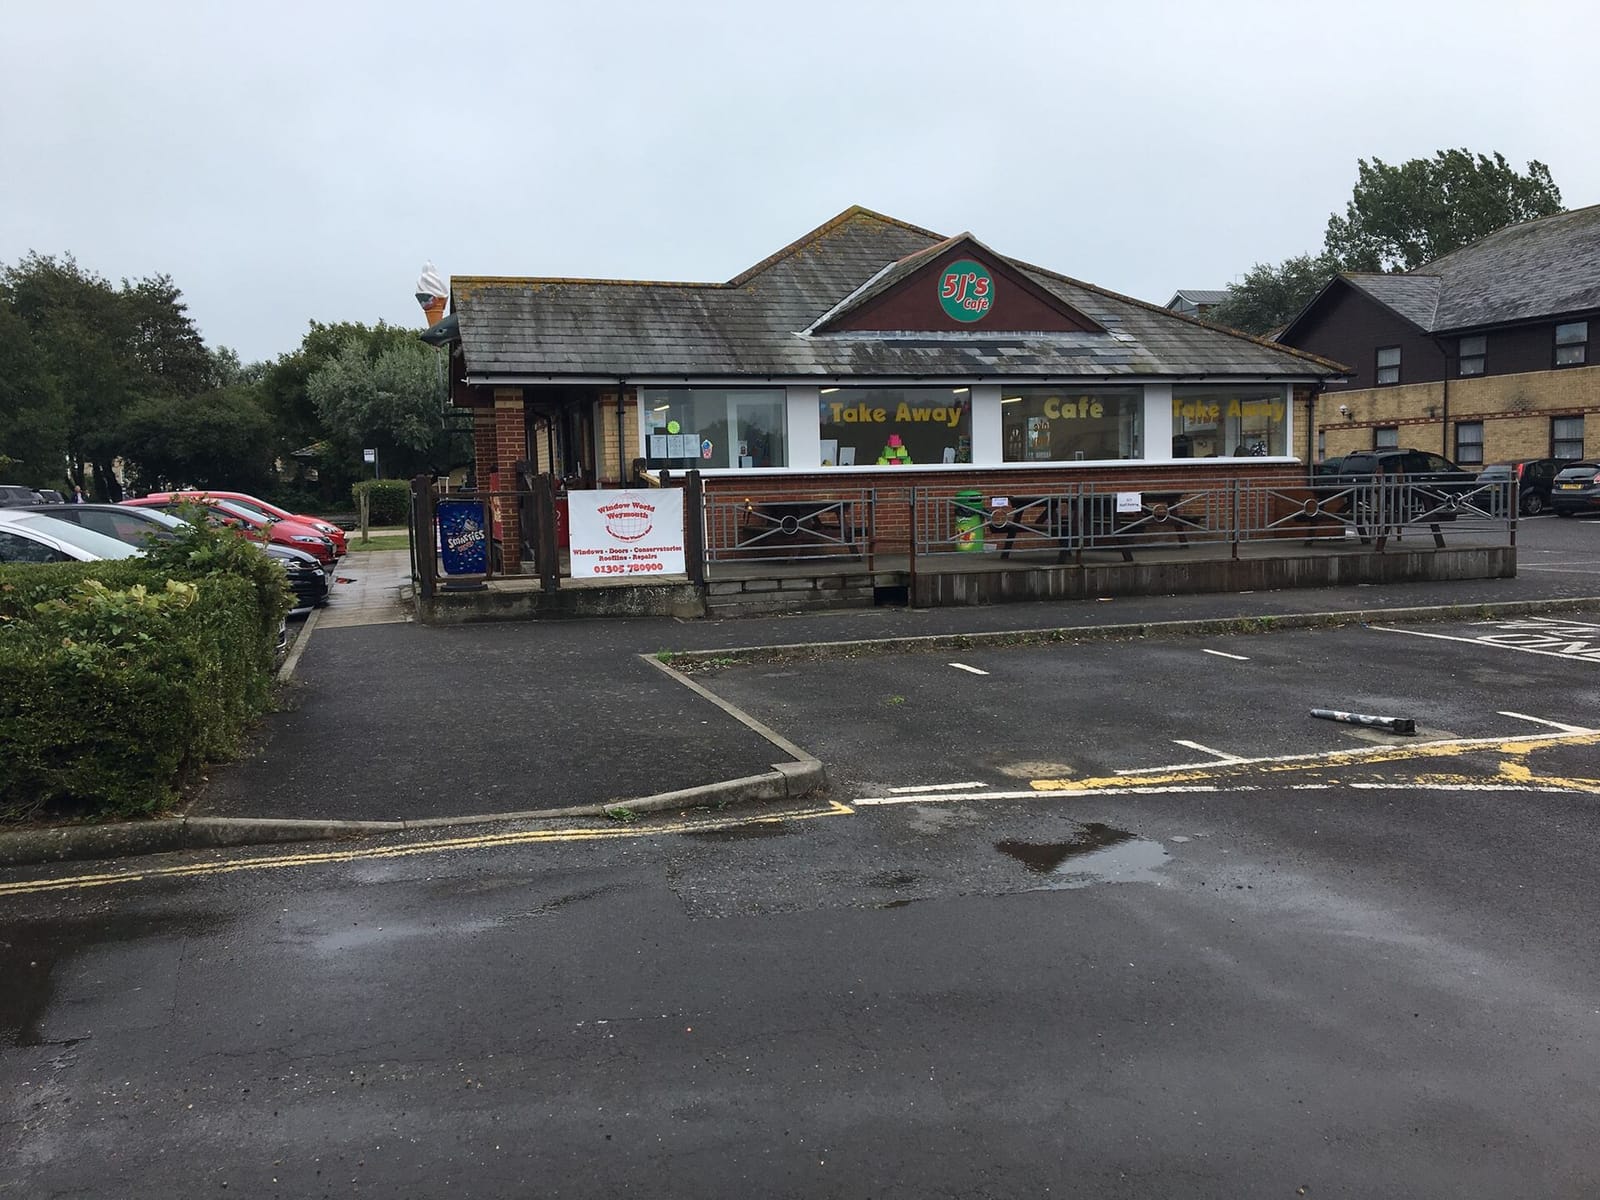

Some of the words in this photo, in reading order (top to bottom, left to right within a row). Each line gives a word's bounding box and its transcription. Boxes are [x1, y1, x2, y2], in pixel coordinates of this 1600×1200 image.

[942, 272, 989, 303] 5J's
[830, 403, 887, 423] Take
[895, 402, 962, 428] Away
[1043, 396, 1104, 419] Café
[1172, 400, 1220, 417] Take
[1227, 400, 1284, 422] Away
[597, 503, 631, 514] Window
[632, 502, 656, 512] World
[594, 564, 625, 574] 01305
